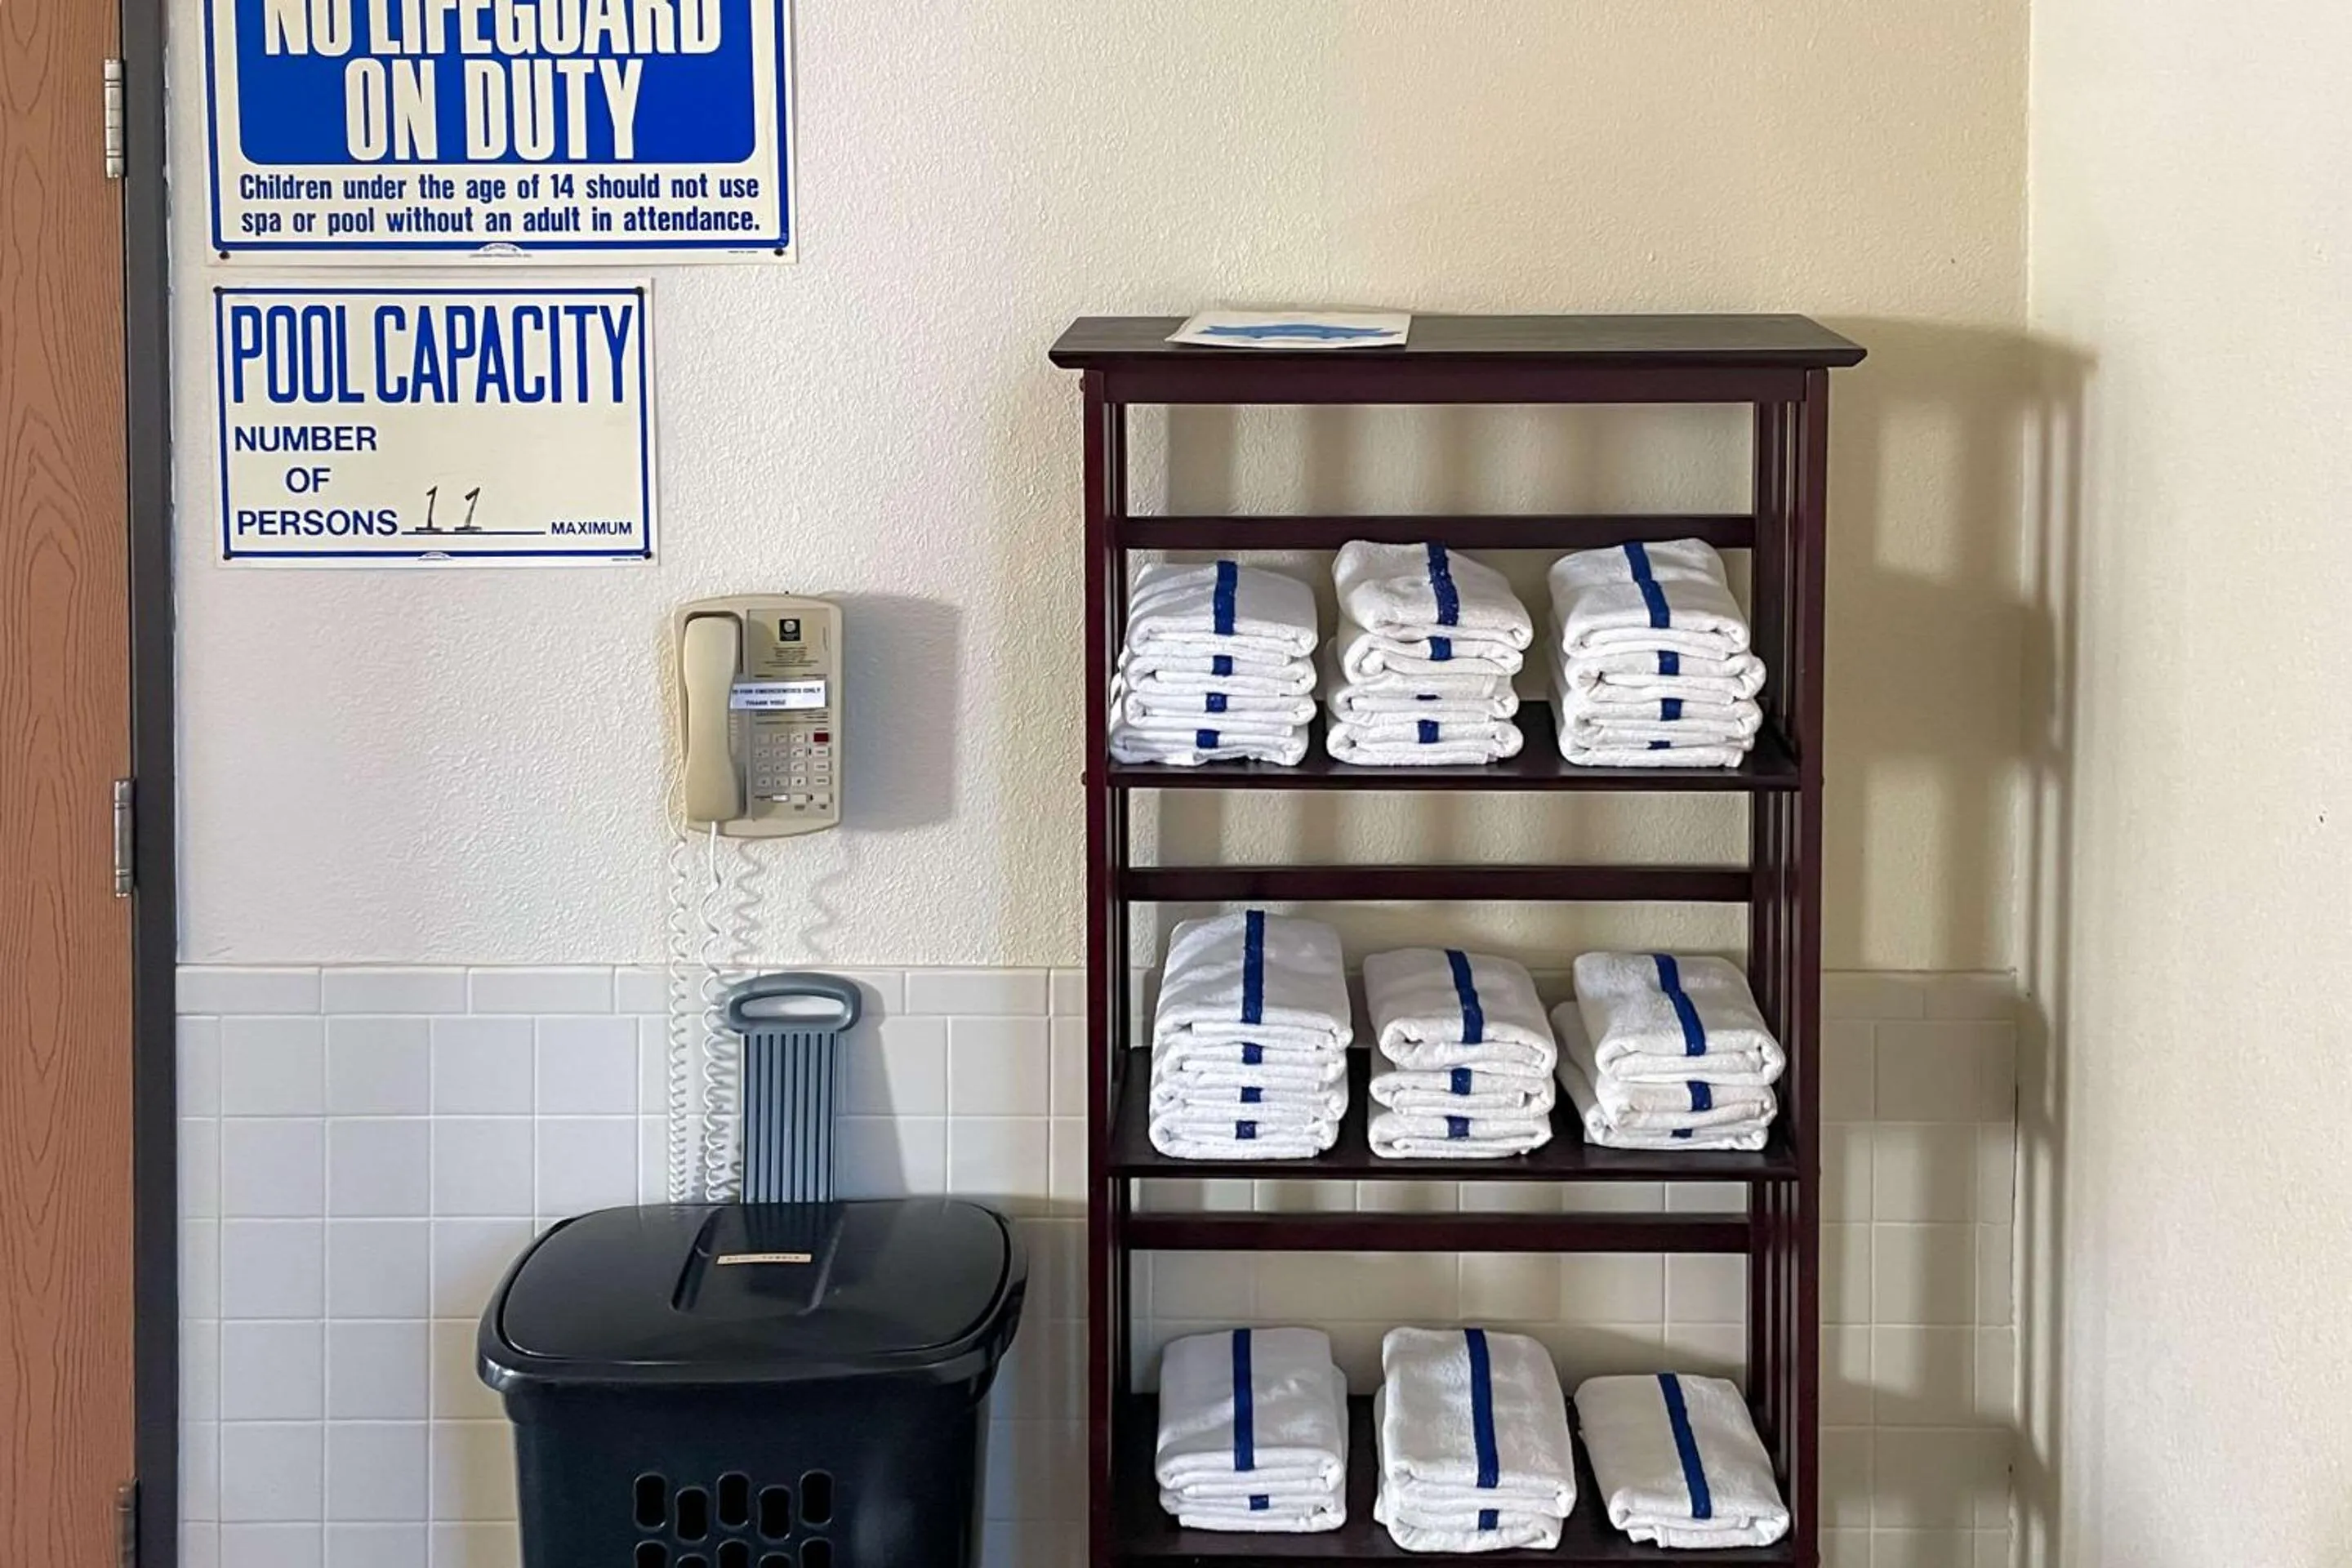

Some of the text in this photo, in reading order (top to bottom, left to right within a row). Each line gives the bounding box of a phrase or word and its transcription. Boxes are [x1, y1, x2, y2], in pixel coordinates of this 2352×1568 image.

[265, 0, 721, 56] NO LIFEGUARD
[345, 58, 644, 161] ON DUTY
[239, 173, 759, 204] Children under the age of 14 should not use
[241, 206, 760, 236] spa or pool without an adult in attendance.
[230, 305, 633, 403] POOL CAPACITY
[234, 425, 377, 452] NUMBER
[286, 467, 331, 492] OF
[237, 509, 398, 536] PERSONS
[551, 521, 632, 536] MAXIMUM
